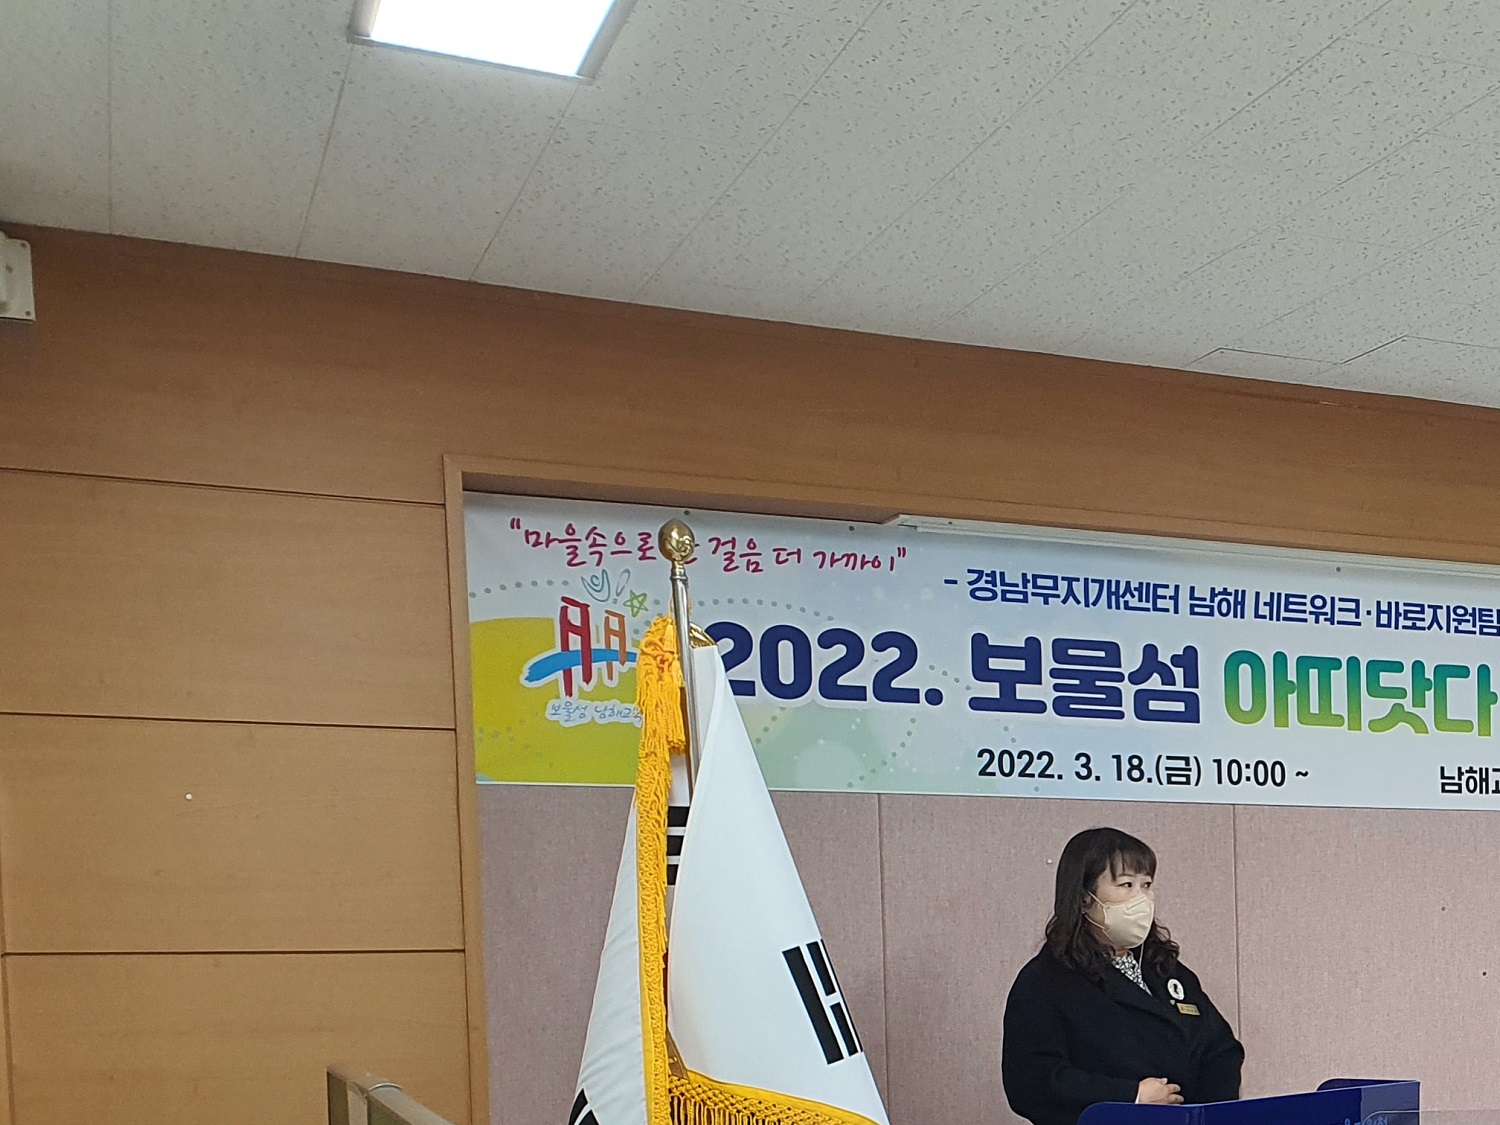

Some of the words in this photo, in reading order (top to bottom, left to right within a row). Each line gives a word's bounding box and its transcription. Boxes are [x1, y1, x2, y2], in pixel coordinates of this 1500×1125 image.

[773, 547, 801, 566] 더
[966, 568, 1181, 615] 경남무지개센터
[1188, 585, 1247, 619] 남해
[705, 621, 943, 706] 2022.
[968, 632, 1201, 724] 보물섬
[1223, 649, 1499, 738] 아띠닷다
[977, 748, 1063, 781] 2022.
[1074, 752, 1101, 782] 3.
[1111, 754, 1202, 787] 18.(금)
[1212, 758, 1286, 788] 10:00
